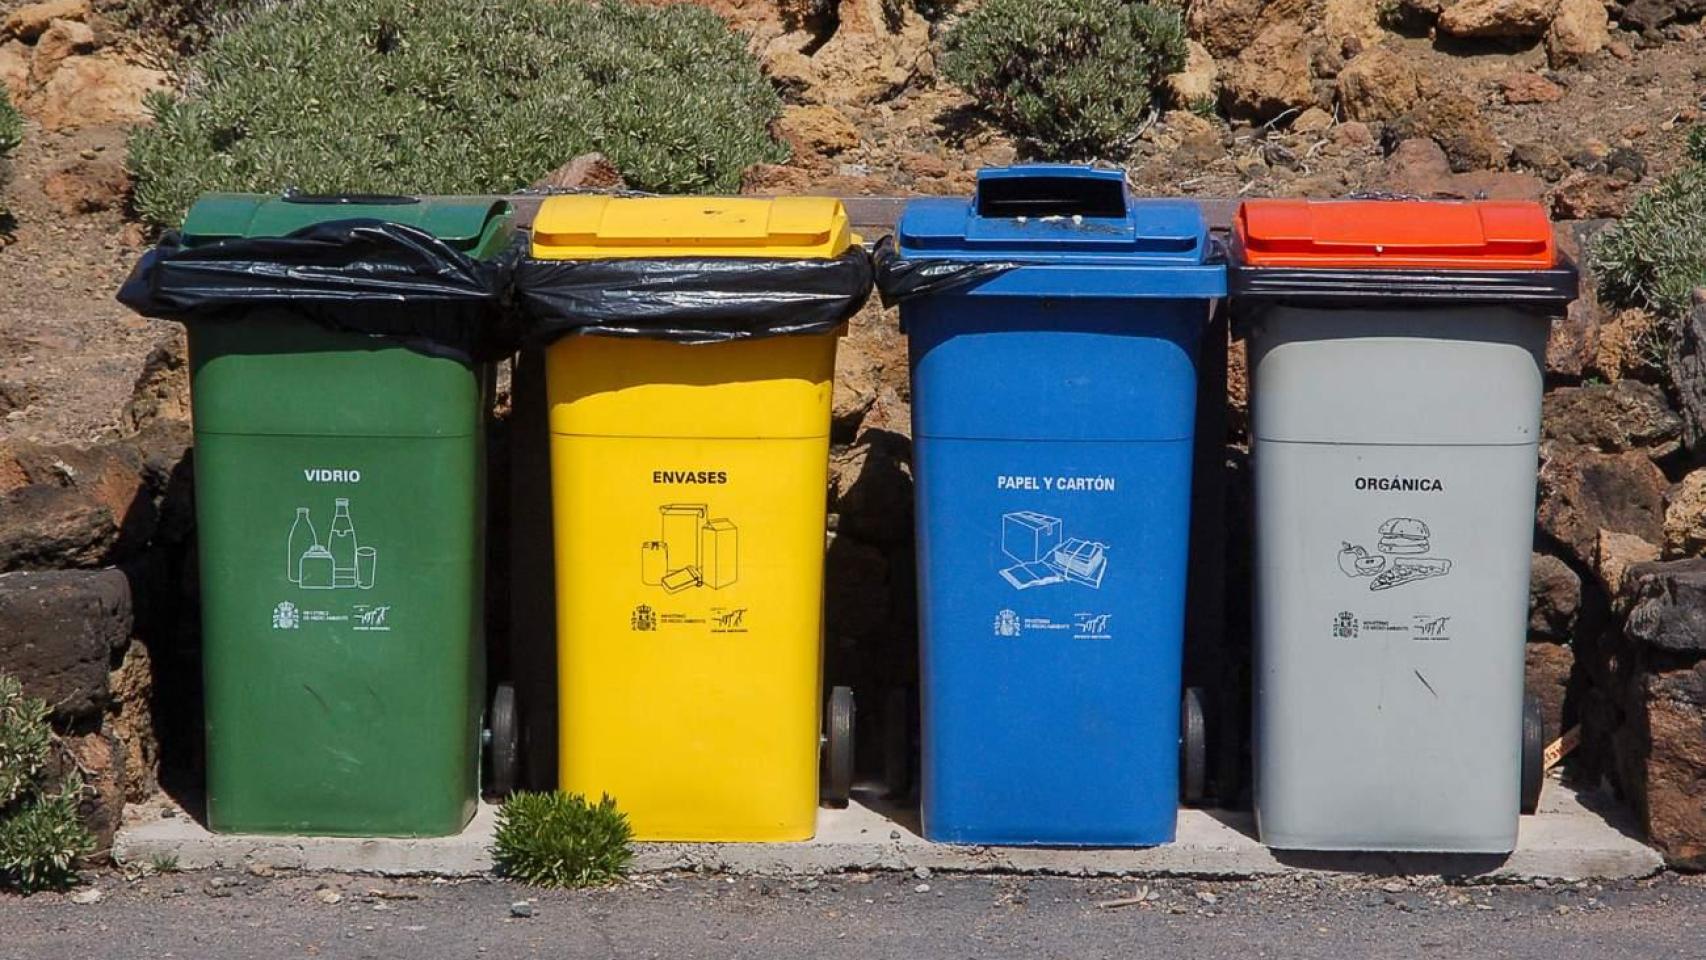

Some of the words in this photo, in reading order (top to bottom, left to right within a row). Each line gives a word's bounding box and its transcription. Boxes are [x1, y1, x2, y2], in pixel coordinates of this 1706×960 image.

[304, 469, 361, 483] VIDRIO
[653, 471, 727, 485] ENVASES
[997, 475, 1040, 490] PAPEL
[1043, 476, 1053, 490] Y
[1056, 474, 1115, 491] CARTÓN
[1355, 475, 1443, 491] ORGÁNICA
